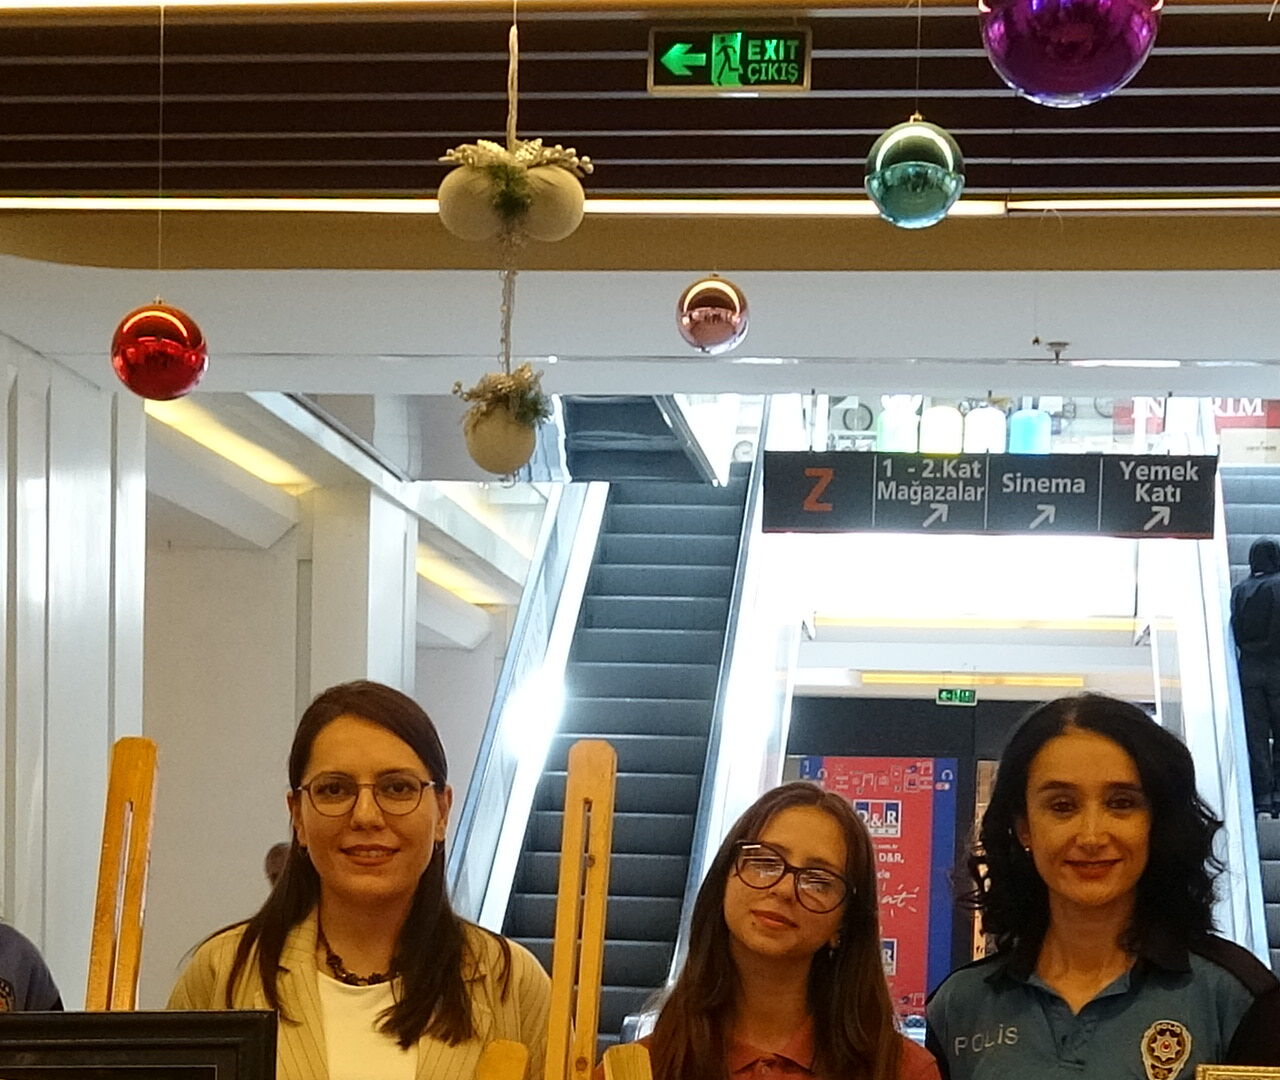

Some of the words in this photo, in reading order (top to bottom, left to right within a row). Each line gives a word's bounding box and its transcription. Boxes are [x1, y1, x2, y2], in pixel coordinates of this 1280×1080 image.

[747, 39, 799, 60] EXIT
[747, 62, 799, 83] ÇIKIŞ
[881, 459, 893, 477] 1
[921, 459, 982, 479] 2.Kat
[1119, 460, 1200, 482] Yemek
[802, 467, 834, 511] Z
[876, 480, 986, 505] Mağazalar
[1001, 472, 1086, 494] Sinema
[1134, 483, 1182, 503] Katı
